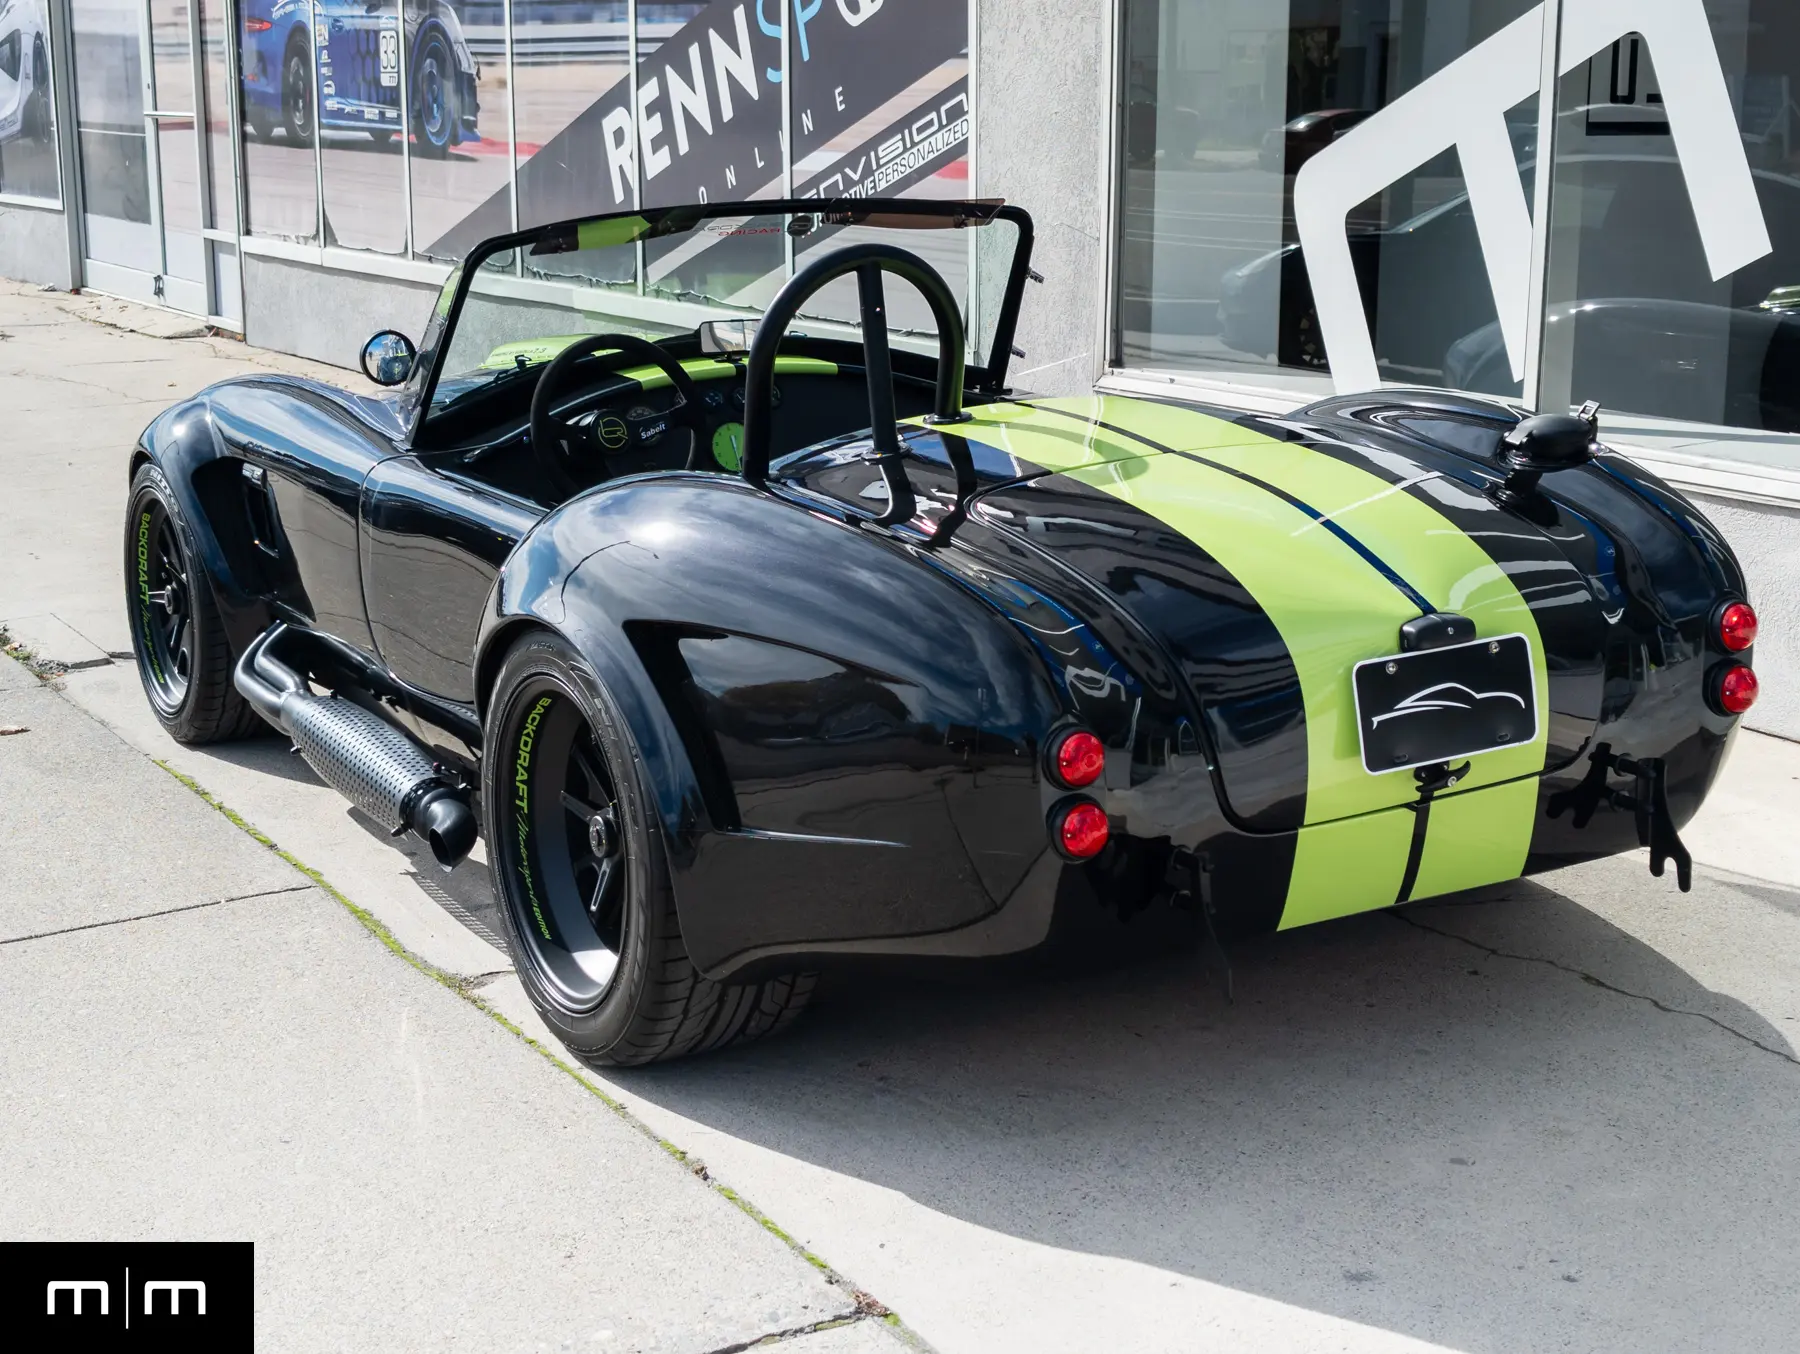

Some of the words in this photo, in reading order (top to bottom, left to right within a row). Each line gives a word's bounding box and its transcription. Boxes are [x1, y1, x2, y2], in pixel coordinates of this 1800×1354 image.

[381, 34, 397, 70] 33
[602, 0, 884, 204] RENNSP
[876, 118, 969, 188] PERSONALIZED
[641, 422, 666, 440] Sabelt
[137, 513, 152, 604] BACKDRAFT
[515, 697, 553, 813] BACKDRAFT
[532, 904, 553, 940] EDITION
